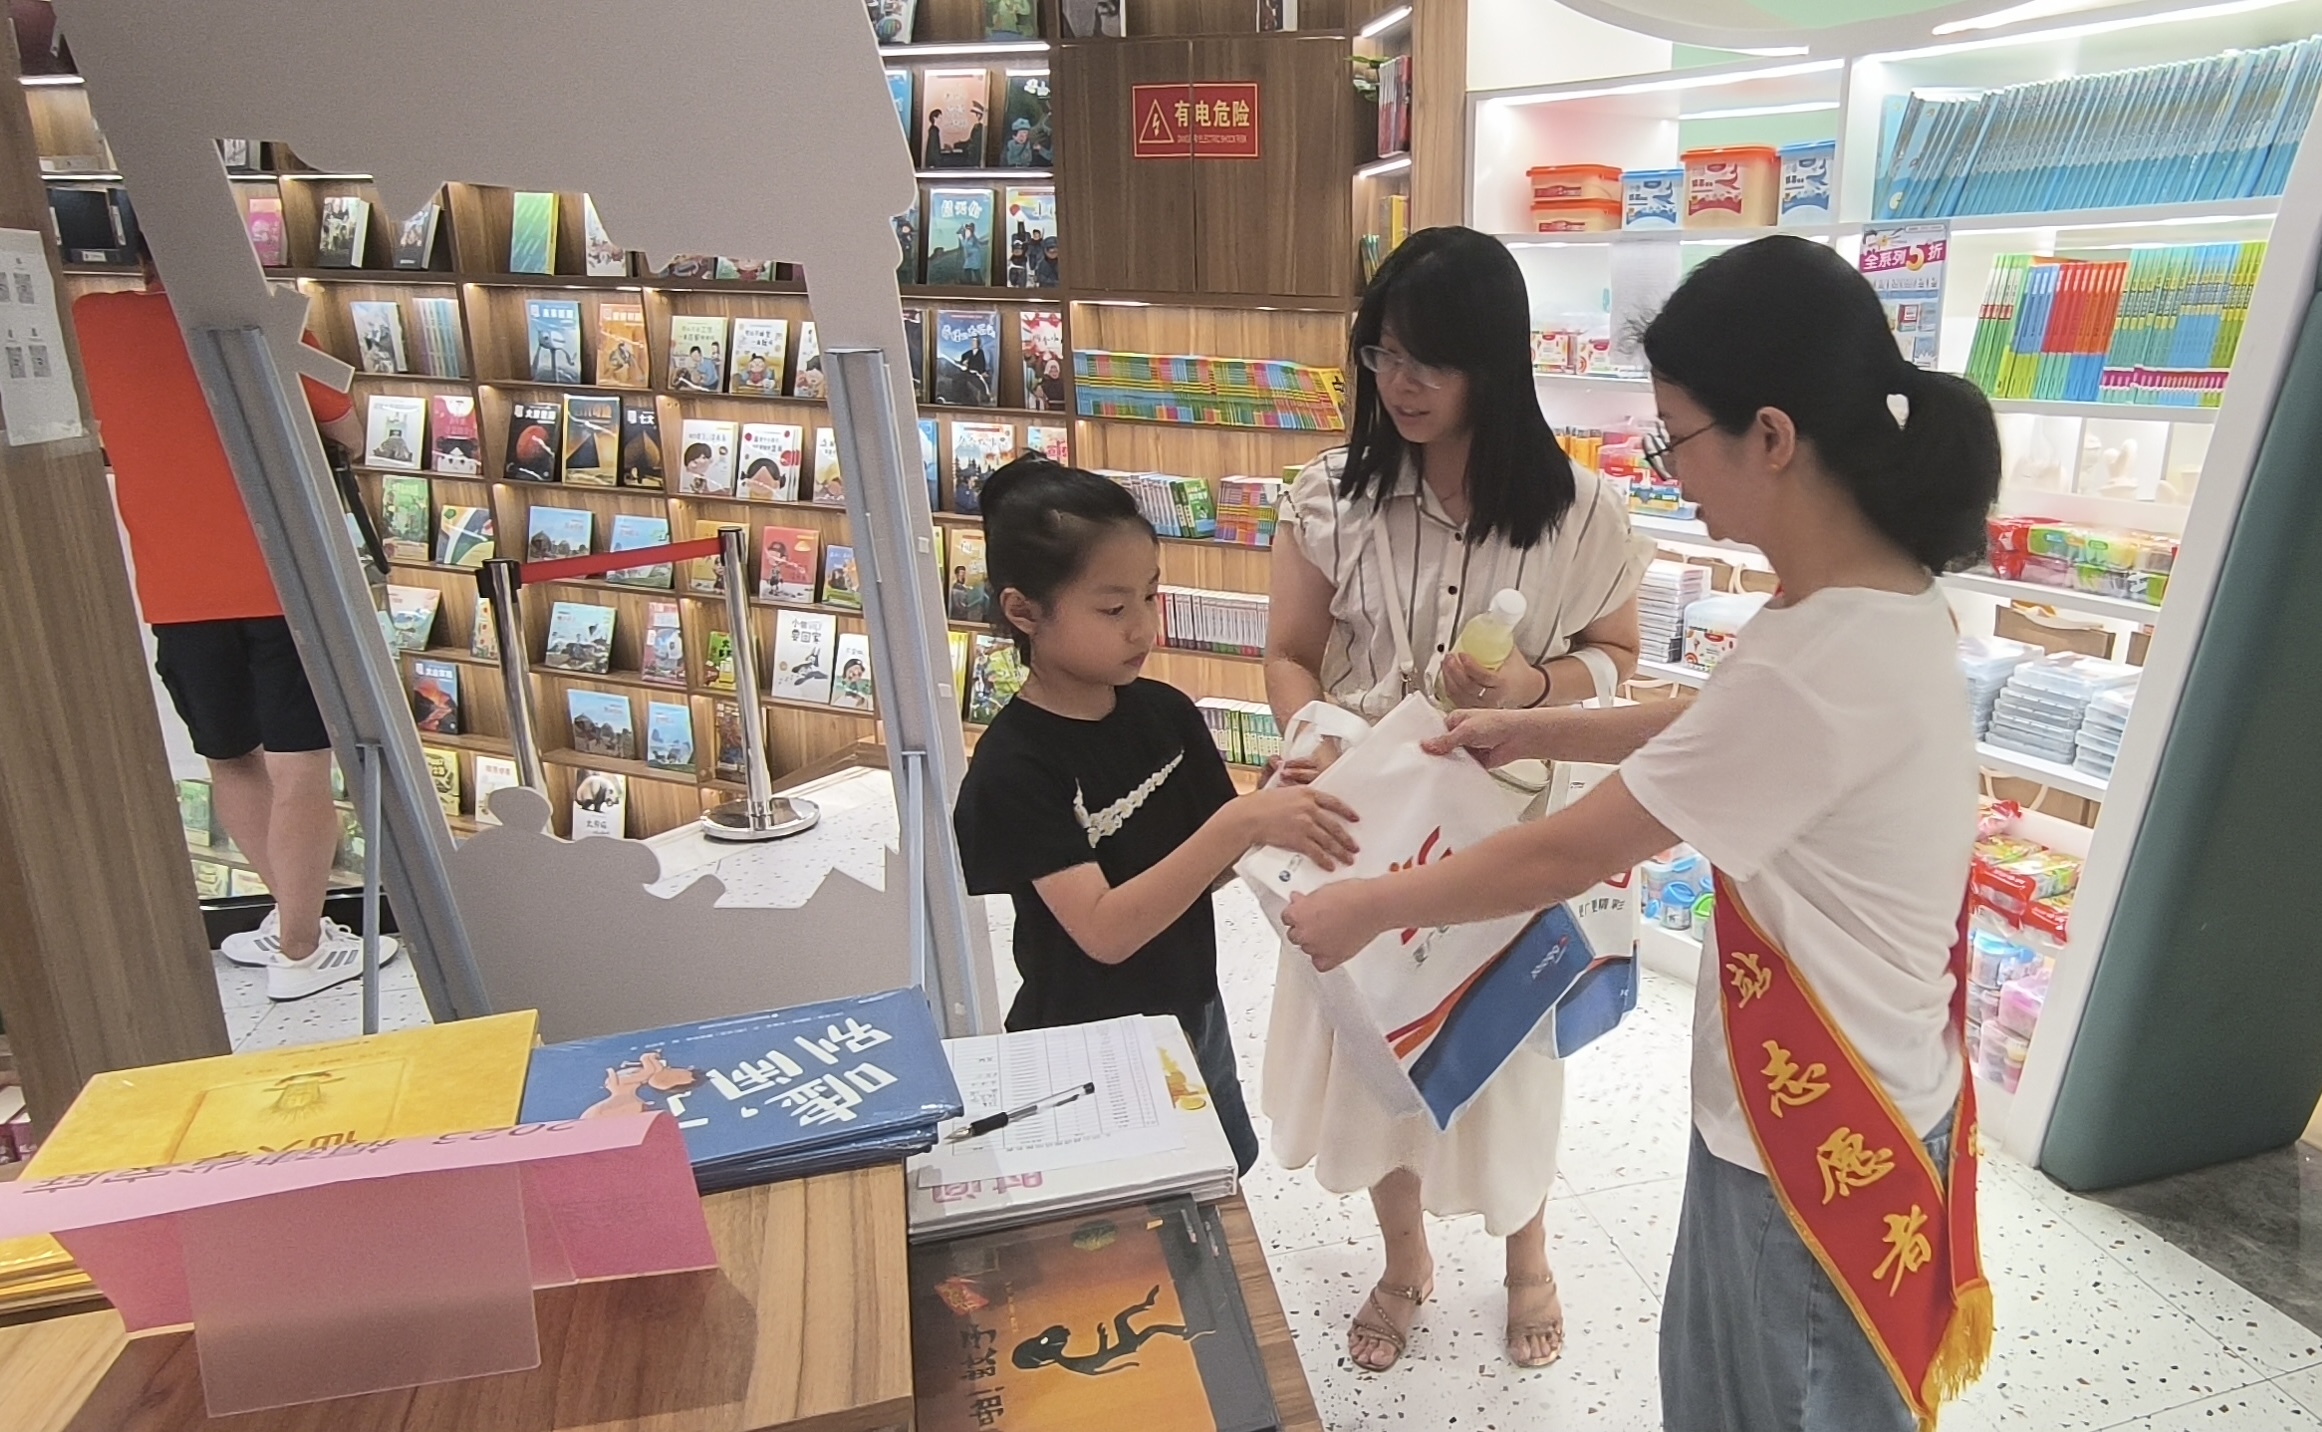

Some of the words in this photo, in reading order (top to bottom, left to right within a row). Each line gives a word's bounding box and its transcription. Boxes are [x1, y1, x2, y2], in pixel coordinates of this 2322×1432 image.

[1174, 99, 1250, 127] 有电危险
[1863, 242, 1944, 271] 全系列5折
